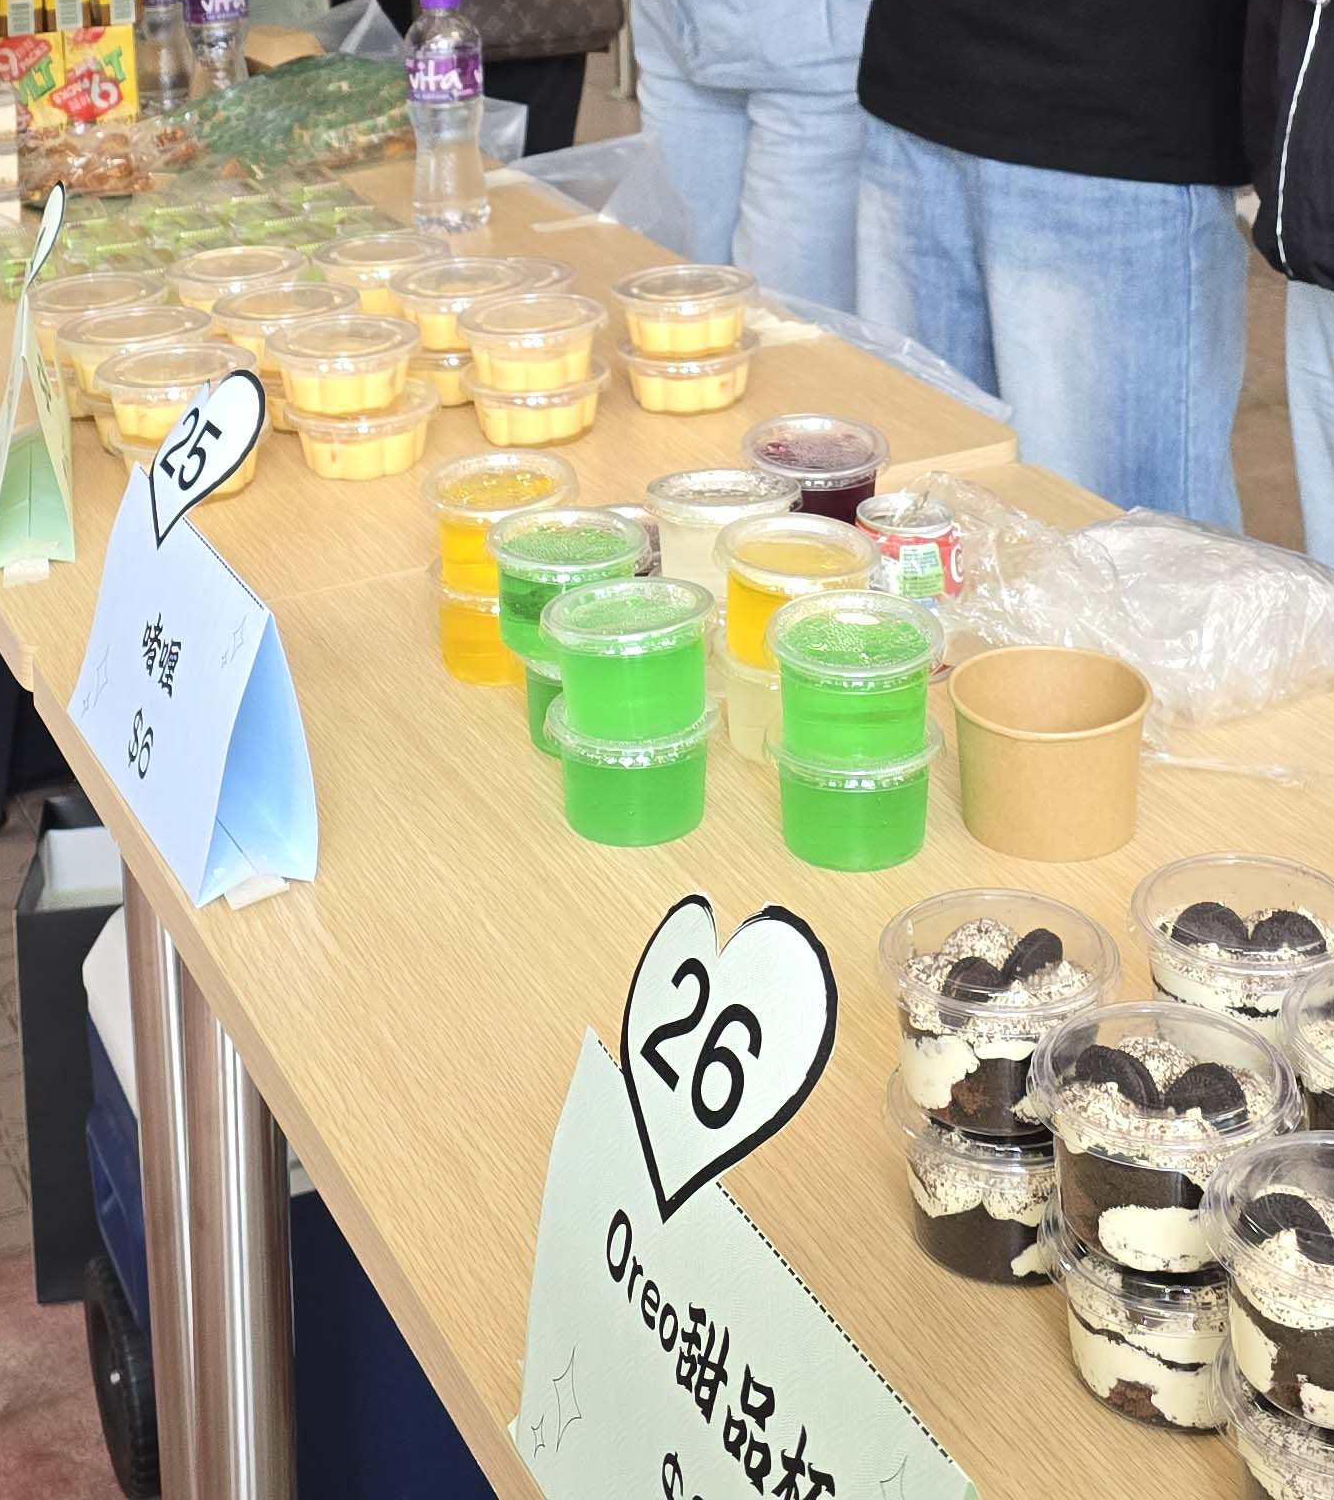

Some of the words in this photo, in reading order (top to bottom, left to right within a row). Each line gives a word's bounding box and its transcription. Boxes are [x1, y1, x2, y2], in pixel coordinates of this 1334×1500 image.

[408, 59, 464, 92] vita
[159, 406, 223, 492] 25
[128, 707, 154, 781] $6
[640, 957, 763, 1130] 26
